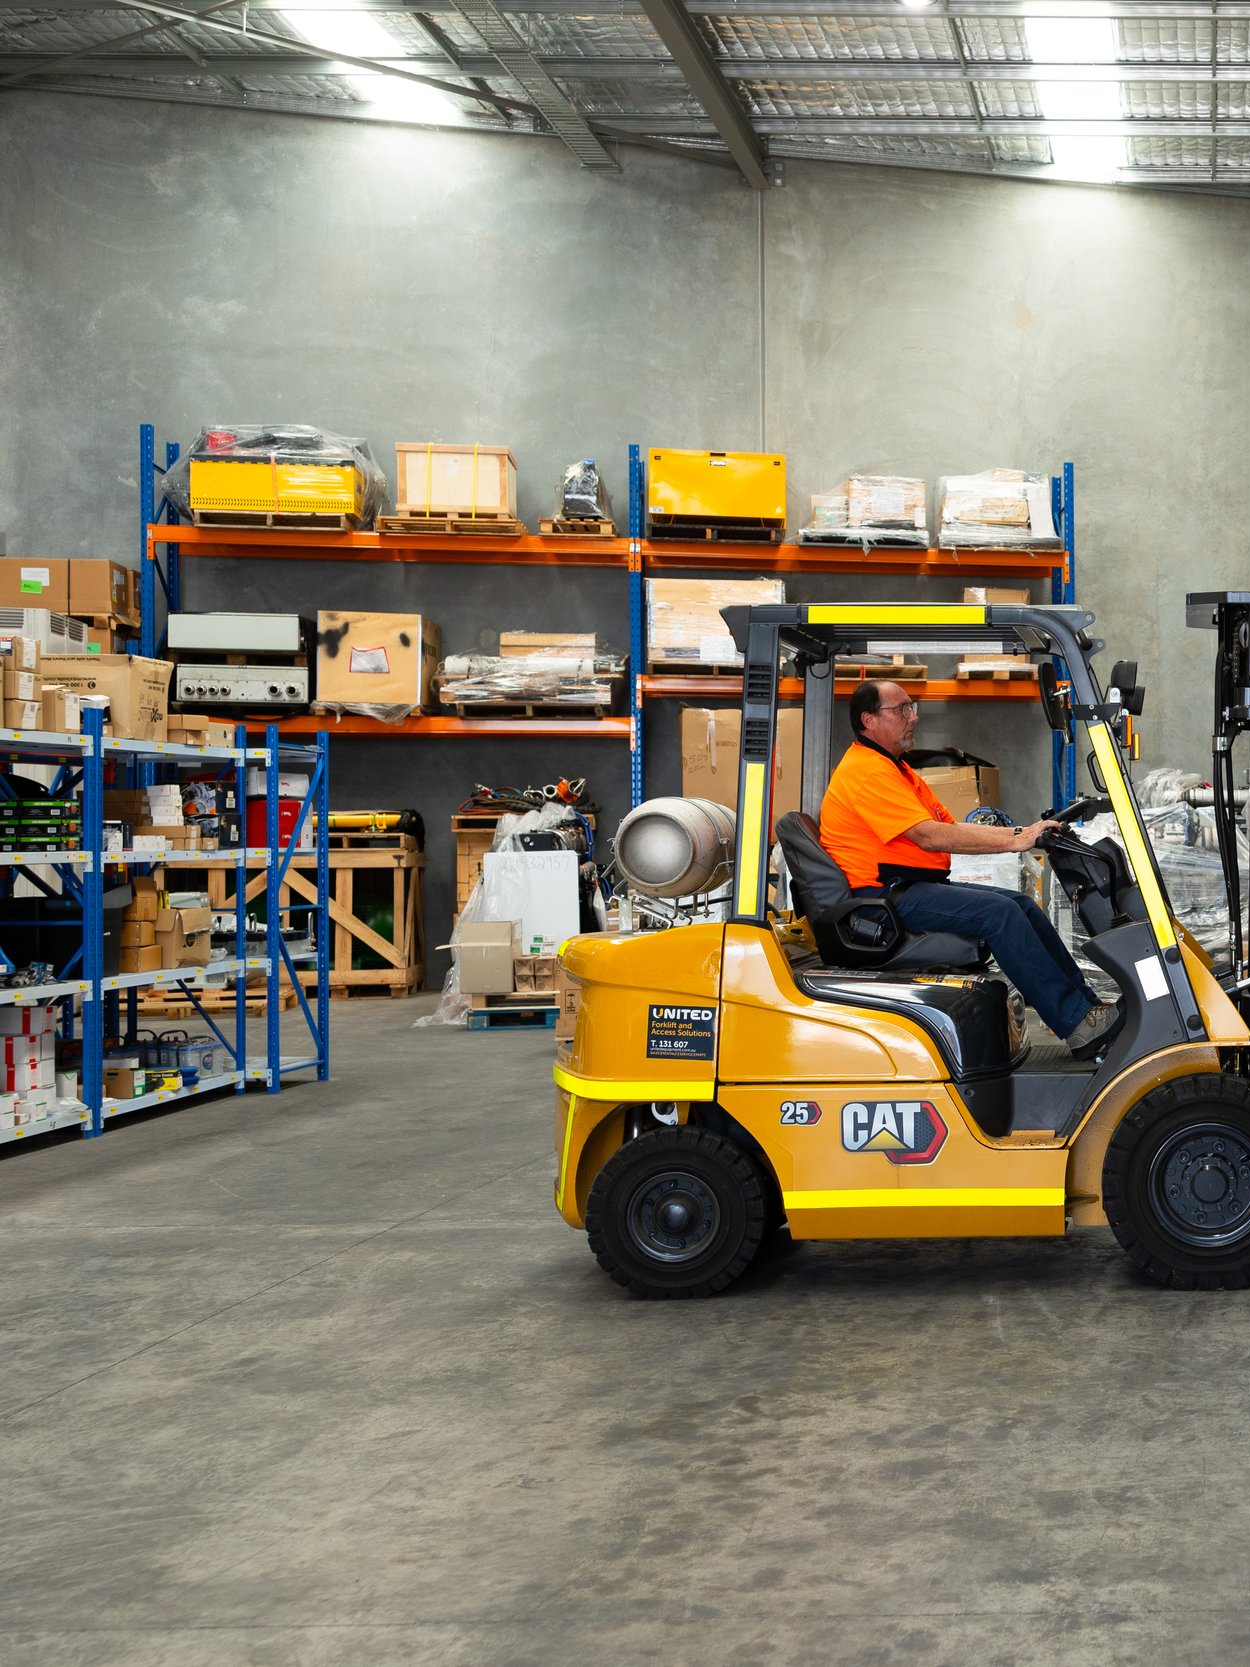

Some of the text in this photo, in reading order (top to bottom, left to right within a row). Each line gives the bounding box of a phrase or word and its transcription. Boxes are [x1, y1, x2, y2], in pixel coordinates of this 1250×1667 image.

[652, 1007, 713, 1021] UNITED
[651, 1020, 677, 1029] Forklift
[651, 1028, 711, 1037] Access Solutions
[650, 1039, 658, 1047] T.
[659, 1040, 672, 1048] 131
[781, 1102, 809, 1124] 25
[842, 1102, 921, 1150] CAT
